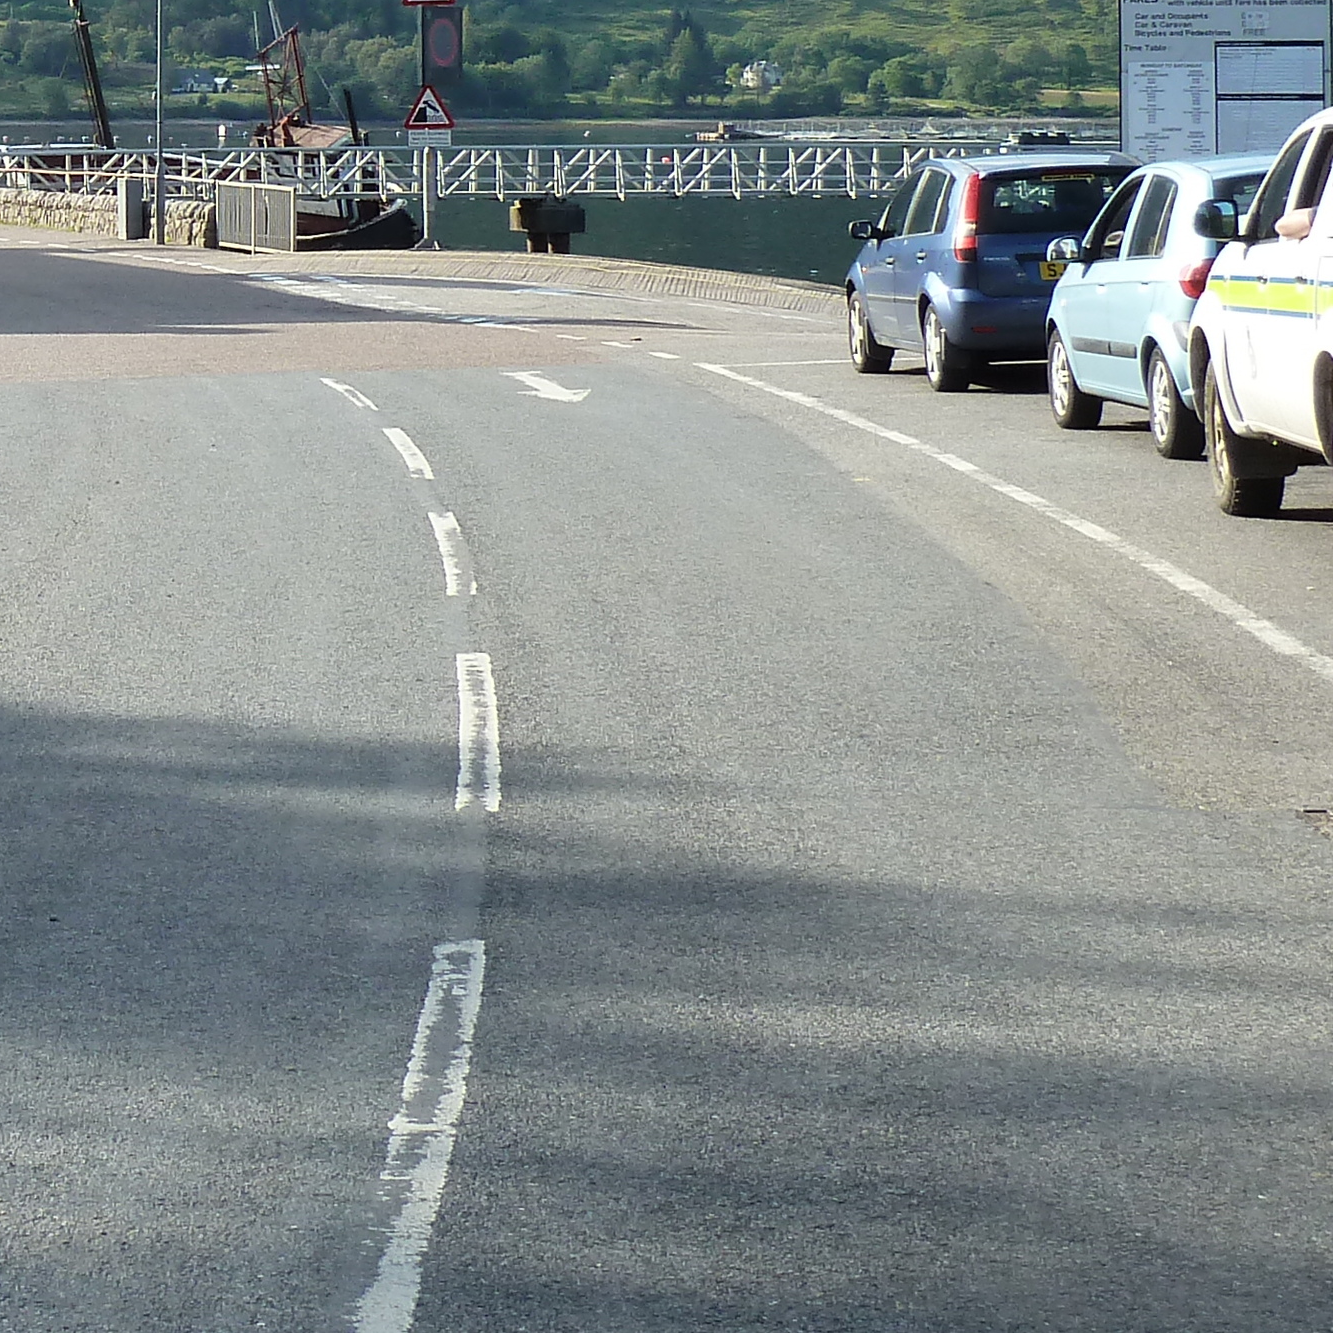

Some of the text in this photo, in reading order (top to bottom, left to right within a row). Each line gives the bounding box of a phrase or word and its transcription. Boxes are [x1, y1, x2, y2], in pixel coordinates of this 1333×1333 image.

[1167, 13, 1209, 21] Occupants
[1134, 29, 1167, 38] Bicycles
[1185, 29, 1231, 37] Pedestrians
